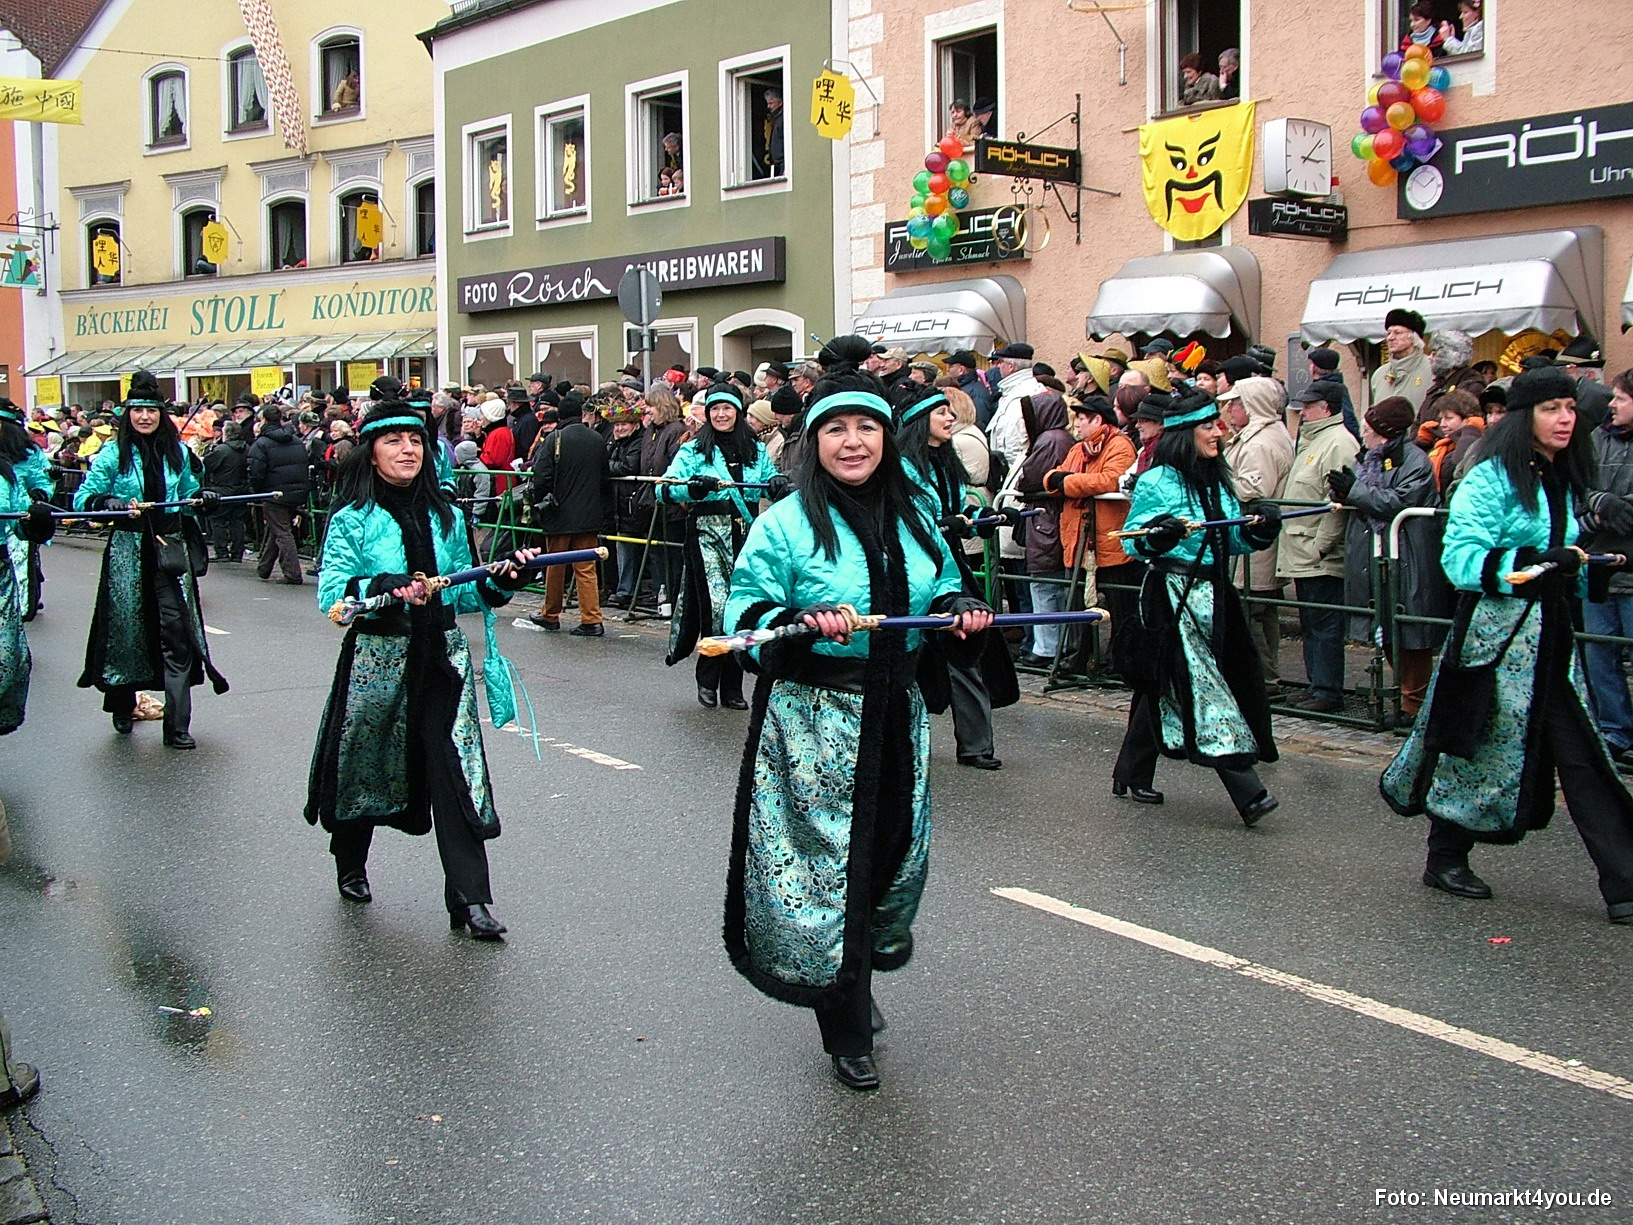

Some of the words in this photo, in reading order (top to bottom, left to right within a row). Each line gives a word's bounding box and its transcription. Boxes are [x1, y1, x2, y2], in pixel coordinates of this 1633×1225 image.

[988, 146, 1070, 168] RÖHLICH
[1590, 166, 1633, 184] Uhr
[1272, 201, 1345, 220] RÖHLICH
[889, 211, 1015, 243] RLICH
[957, 245, 990, 261] Schmuck
[464, 281, 498, 305] FOTO
[506, 267, 612, 306] Rösch
[625, 248, 763, 283] HREIBWAREN
[1335, 279, 1503, 306] RÖHLICH
[76, 307, 169, 336] BÄCKEREI
[190, 293, 285, 336] STOLL
[312, 286, 437, 320] KONDITOR
[854, 319, 950, 335] RÖHLICH
